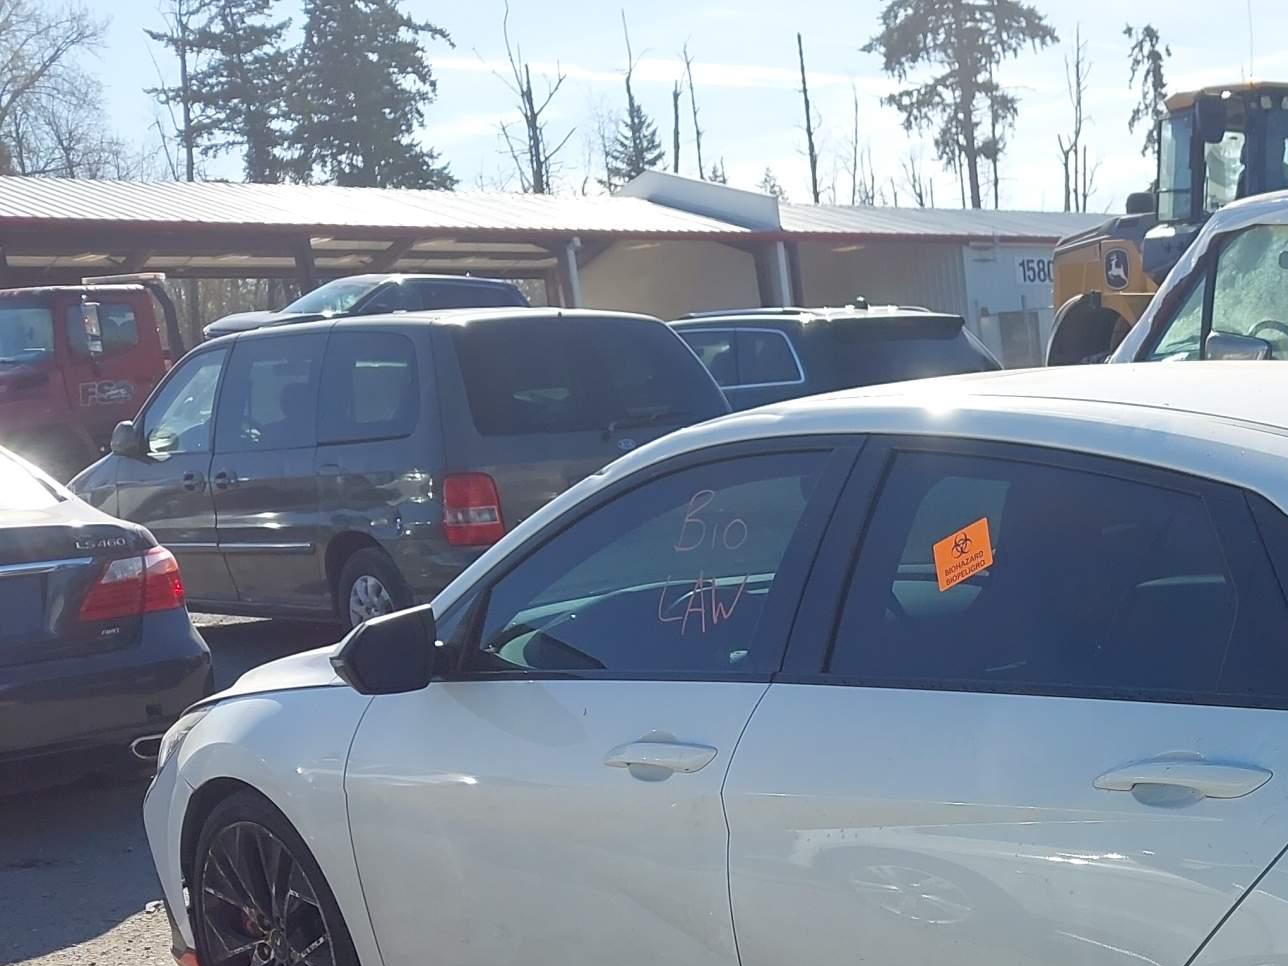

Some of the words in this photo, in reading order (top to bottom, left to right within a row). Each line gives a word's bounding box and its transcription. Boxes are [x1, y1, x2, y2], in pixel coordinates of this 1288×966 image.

[944, 550, 984, 577] BIOHAZARD
[945, 559, 986, 586] BIOPELIGRO
[658, 570, 750, 636] LAW
